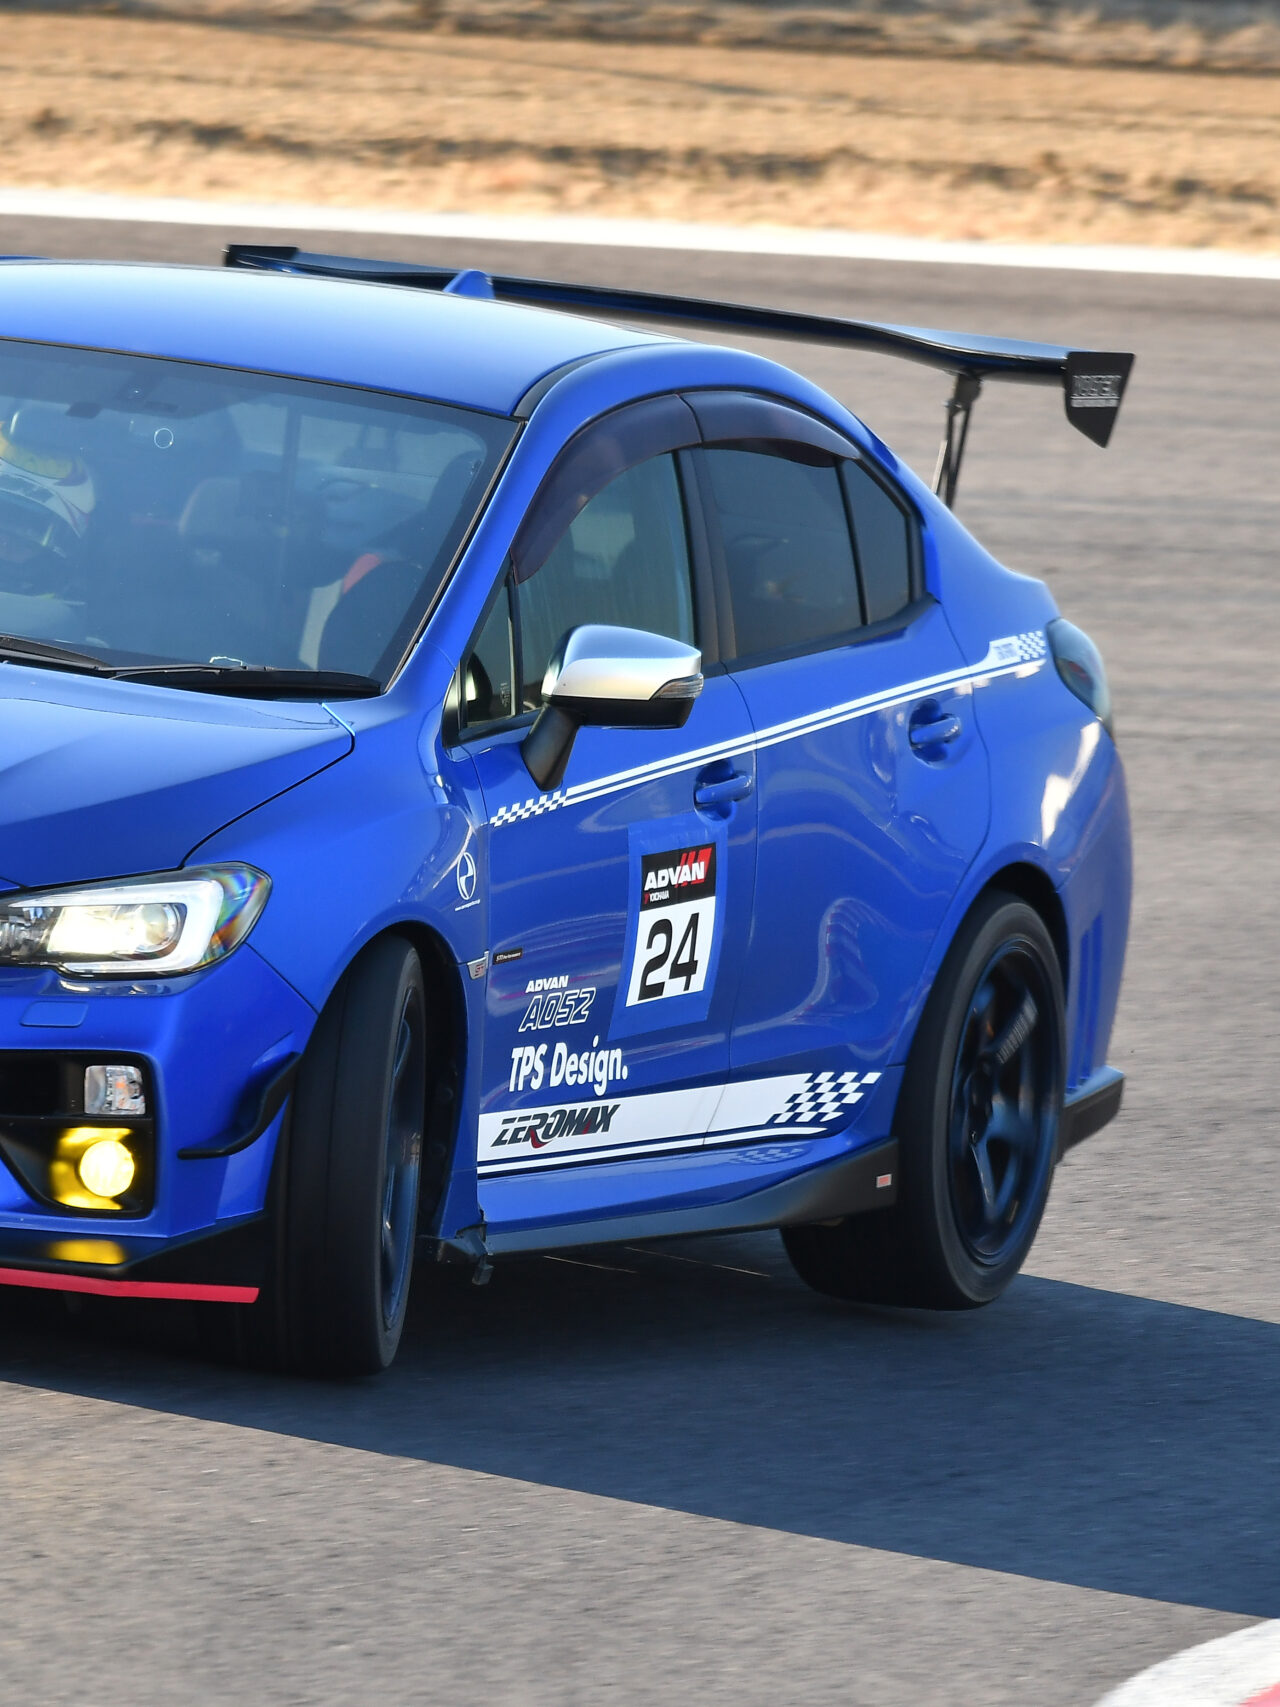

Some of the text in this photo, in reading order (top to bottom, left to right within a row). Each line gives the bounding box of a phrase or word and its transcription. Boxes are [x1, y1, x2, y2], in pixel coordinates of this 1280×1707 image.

[644, 861, 705, 891] ADVAN
[638, 912, 700, 1001] 24
[525, 975, 569, 993] ADVAN
[509, 1035, 628, 1096] TPS Design.
[490, 1104, 621, 1149] ZEROMAX
